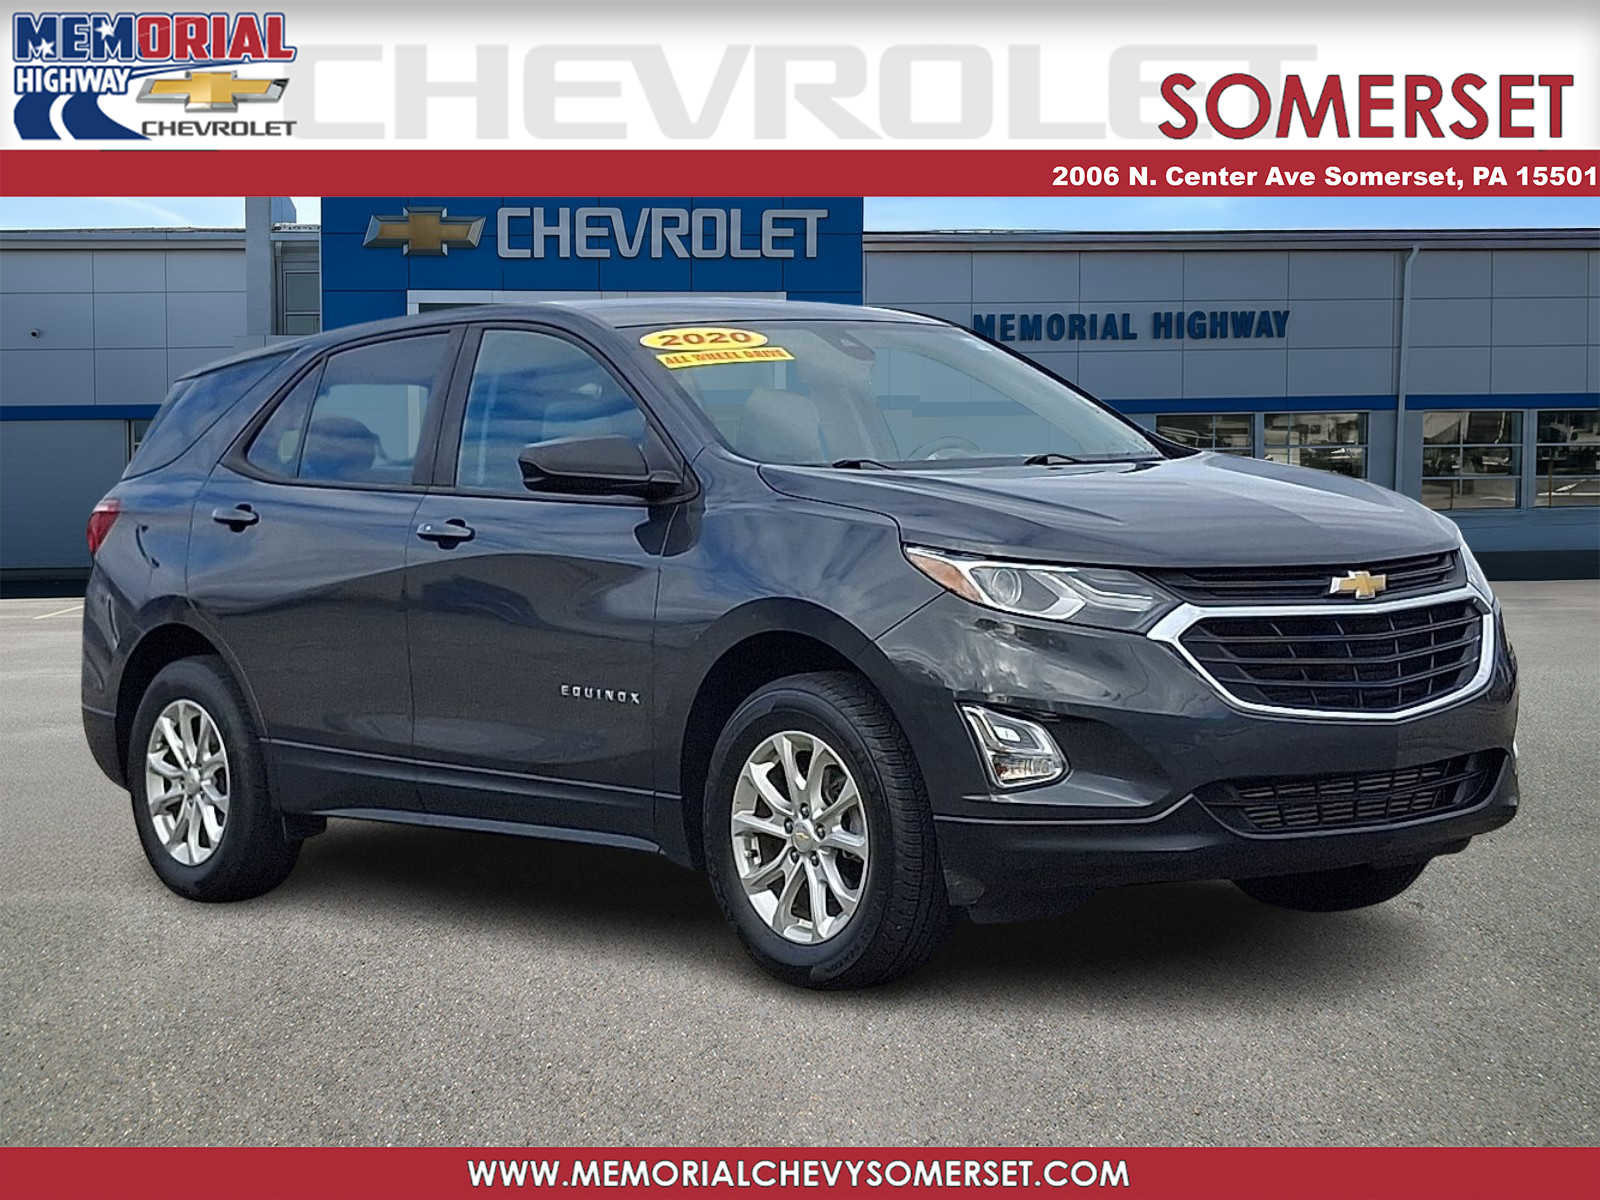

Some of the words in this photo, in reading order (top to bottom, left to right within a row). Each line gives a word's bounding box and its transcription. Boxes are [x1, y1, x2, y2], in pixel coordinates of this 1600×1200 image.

[496, 206, 829, 259] CHEVROLET
[973, 313, 1138, 341] MEMORIAL
[1152, 310, 1290, 339] HIGHWAY
[658, 331, 752, 347] 2020
[664, 355, 691, 365] ALL
[693, 351, 738, 362] WHEEL
[744, 349, 787, 359] DRIVE
[560, 684, 641, 705] EQUINOX
